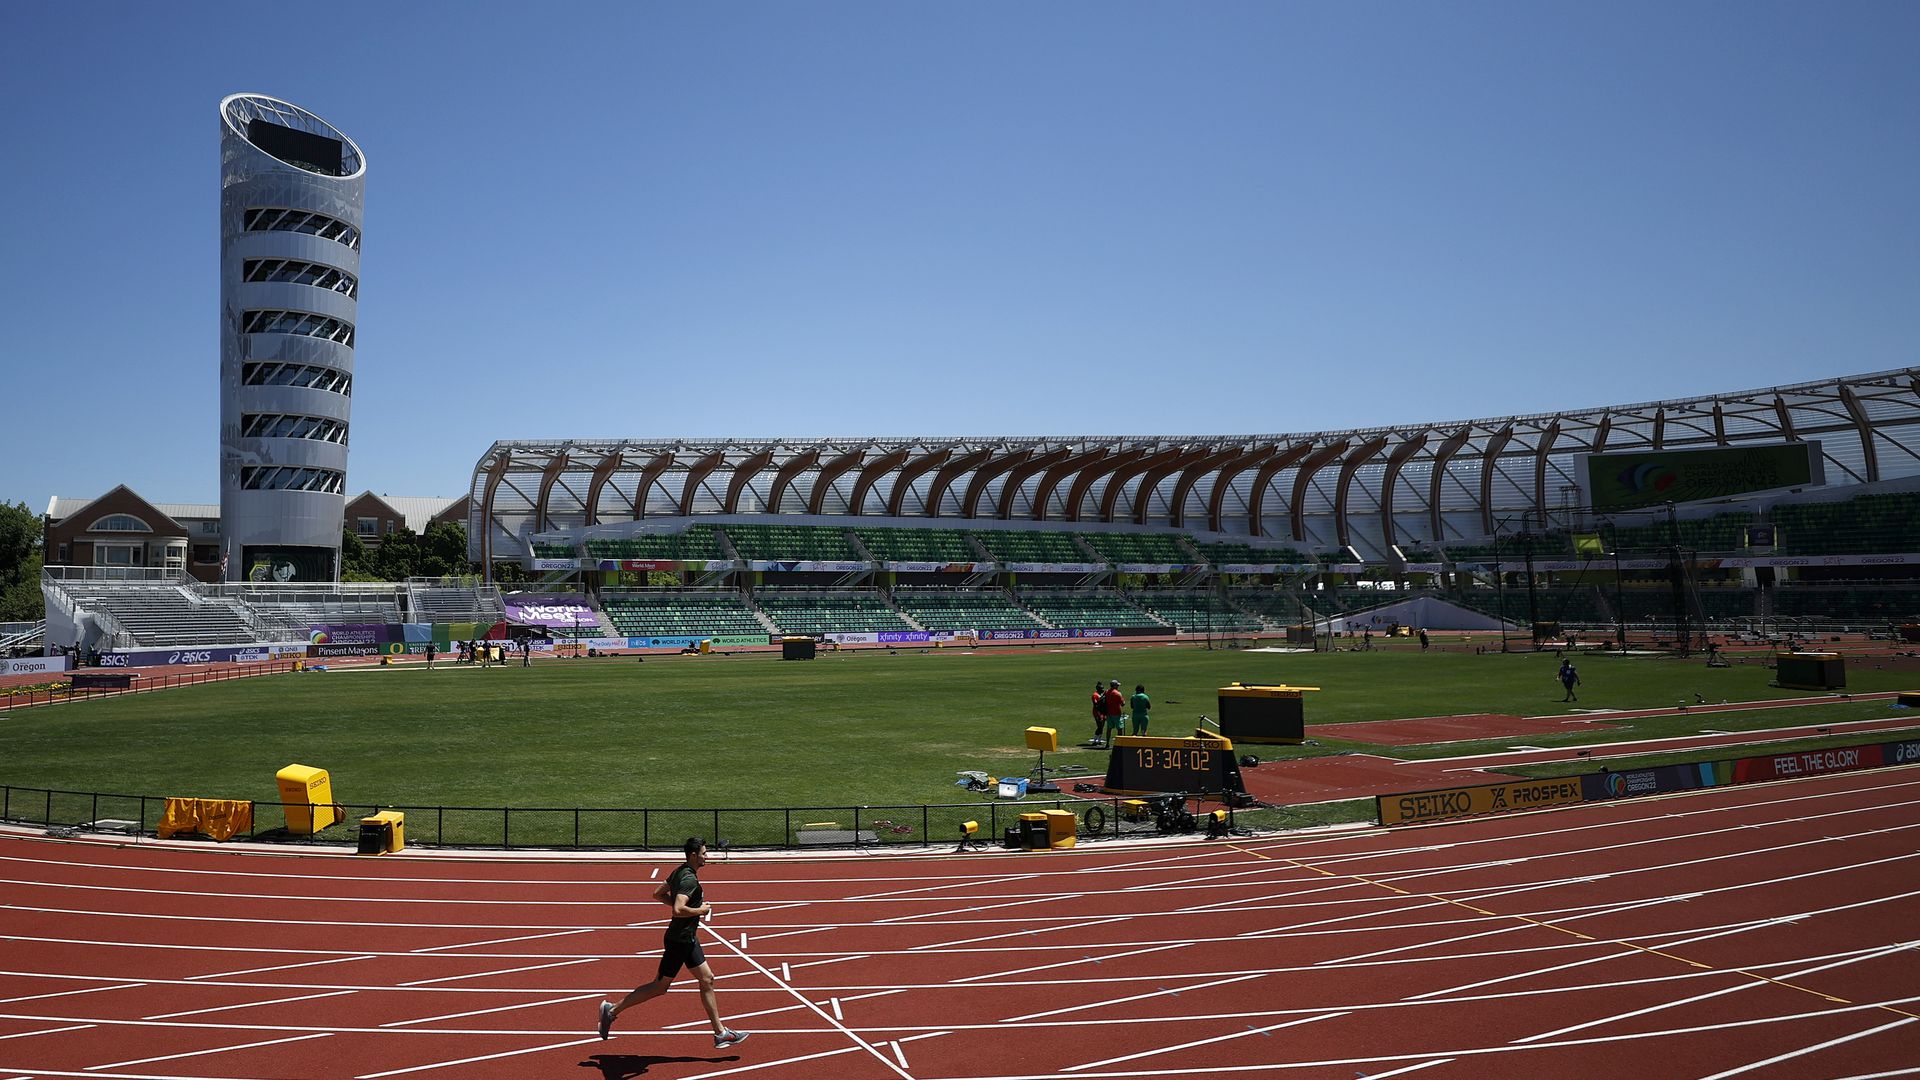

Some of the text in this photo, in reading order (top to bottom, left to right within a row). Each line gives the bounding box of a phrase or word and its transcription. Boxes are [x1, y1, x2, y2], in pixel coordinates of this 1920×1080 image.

[523, 605, 588, 613] World.
[518, 611, 574, 620] Meet
[879, 633, 902, 642] xfinity
[906, 632, 928, 642] xfinity
[318, 646, 379, 656] Pinsent Masons
[12, 662, 46, 672] Oregon
[1136, 748, 1210, 770] 13:34:02
[1774, 750, 1860, 774] FEEL THE GLORY
[309, 776, 326, 789] SEIKO
[1627, 781, 1657, 791] OREGON22
[1399, 783, 1578, 819] SEIKO PROSPEX
